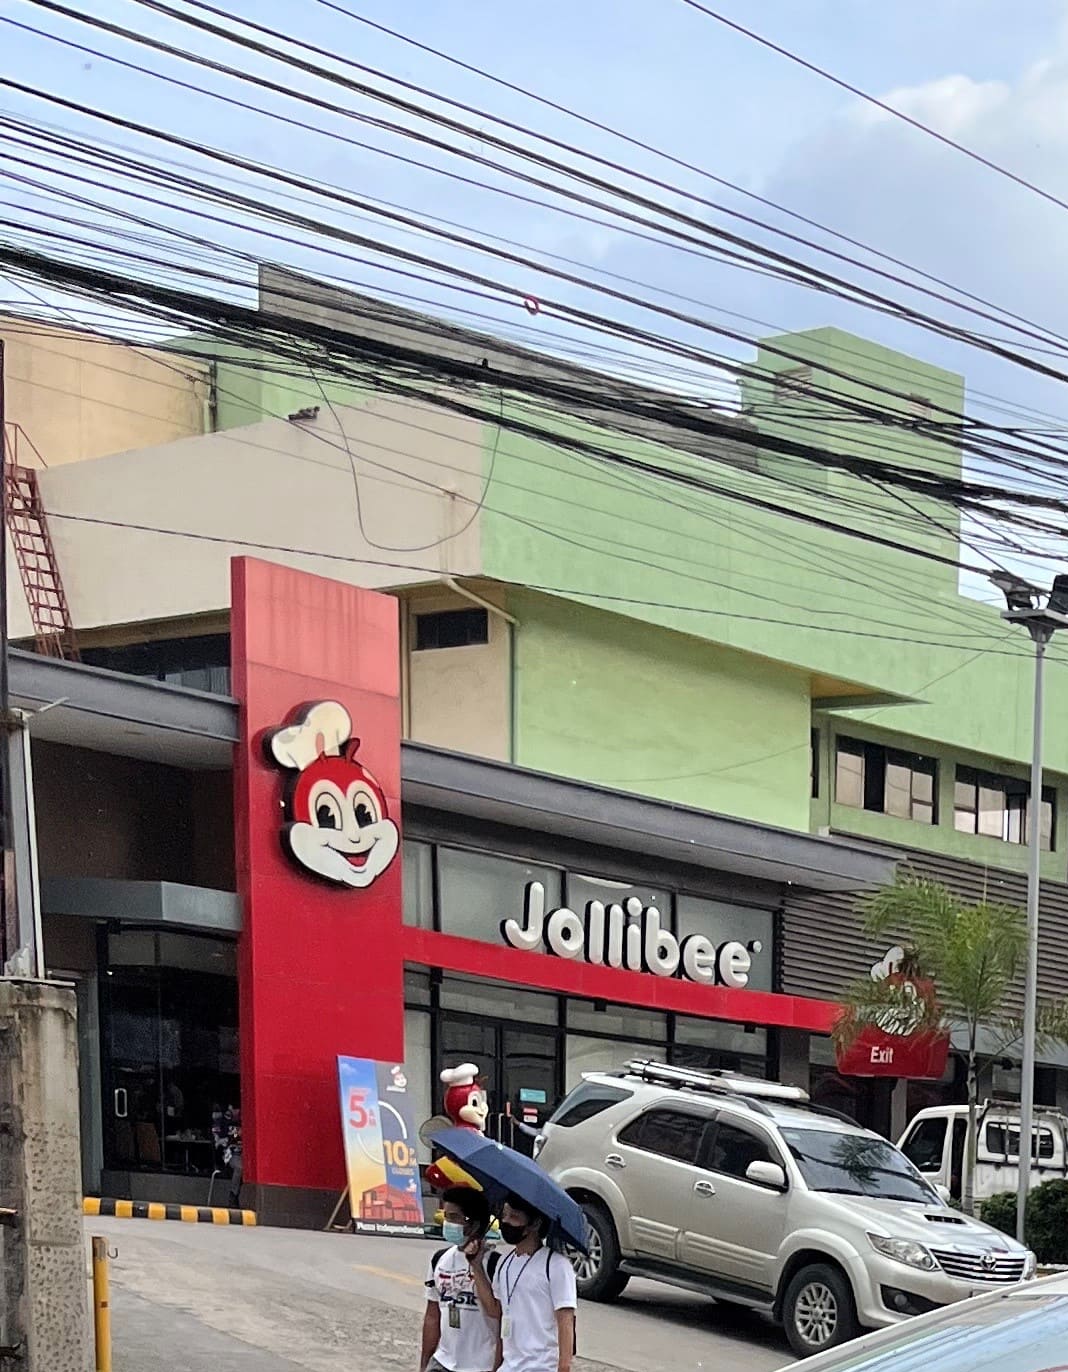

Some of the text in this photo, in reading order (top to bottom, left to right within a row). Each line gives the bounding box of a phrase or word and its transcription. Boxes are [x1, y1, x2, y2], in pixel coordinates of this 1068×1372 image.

[501, 881, 751, 988] Jollibee
[870, 1046, 894, 1064] Exit
[349, 1095, 368, 1129] 5
[383, 1140, 409, 1168] 10
